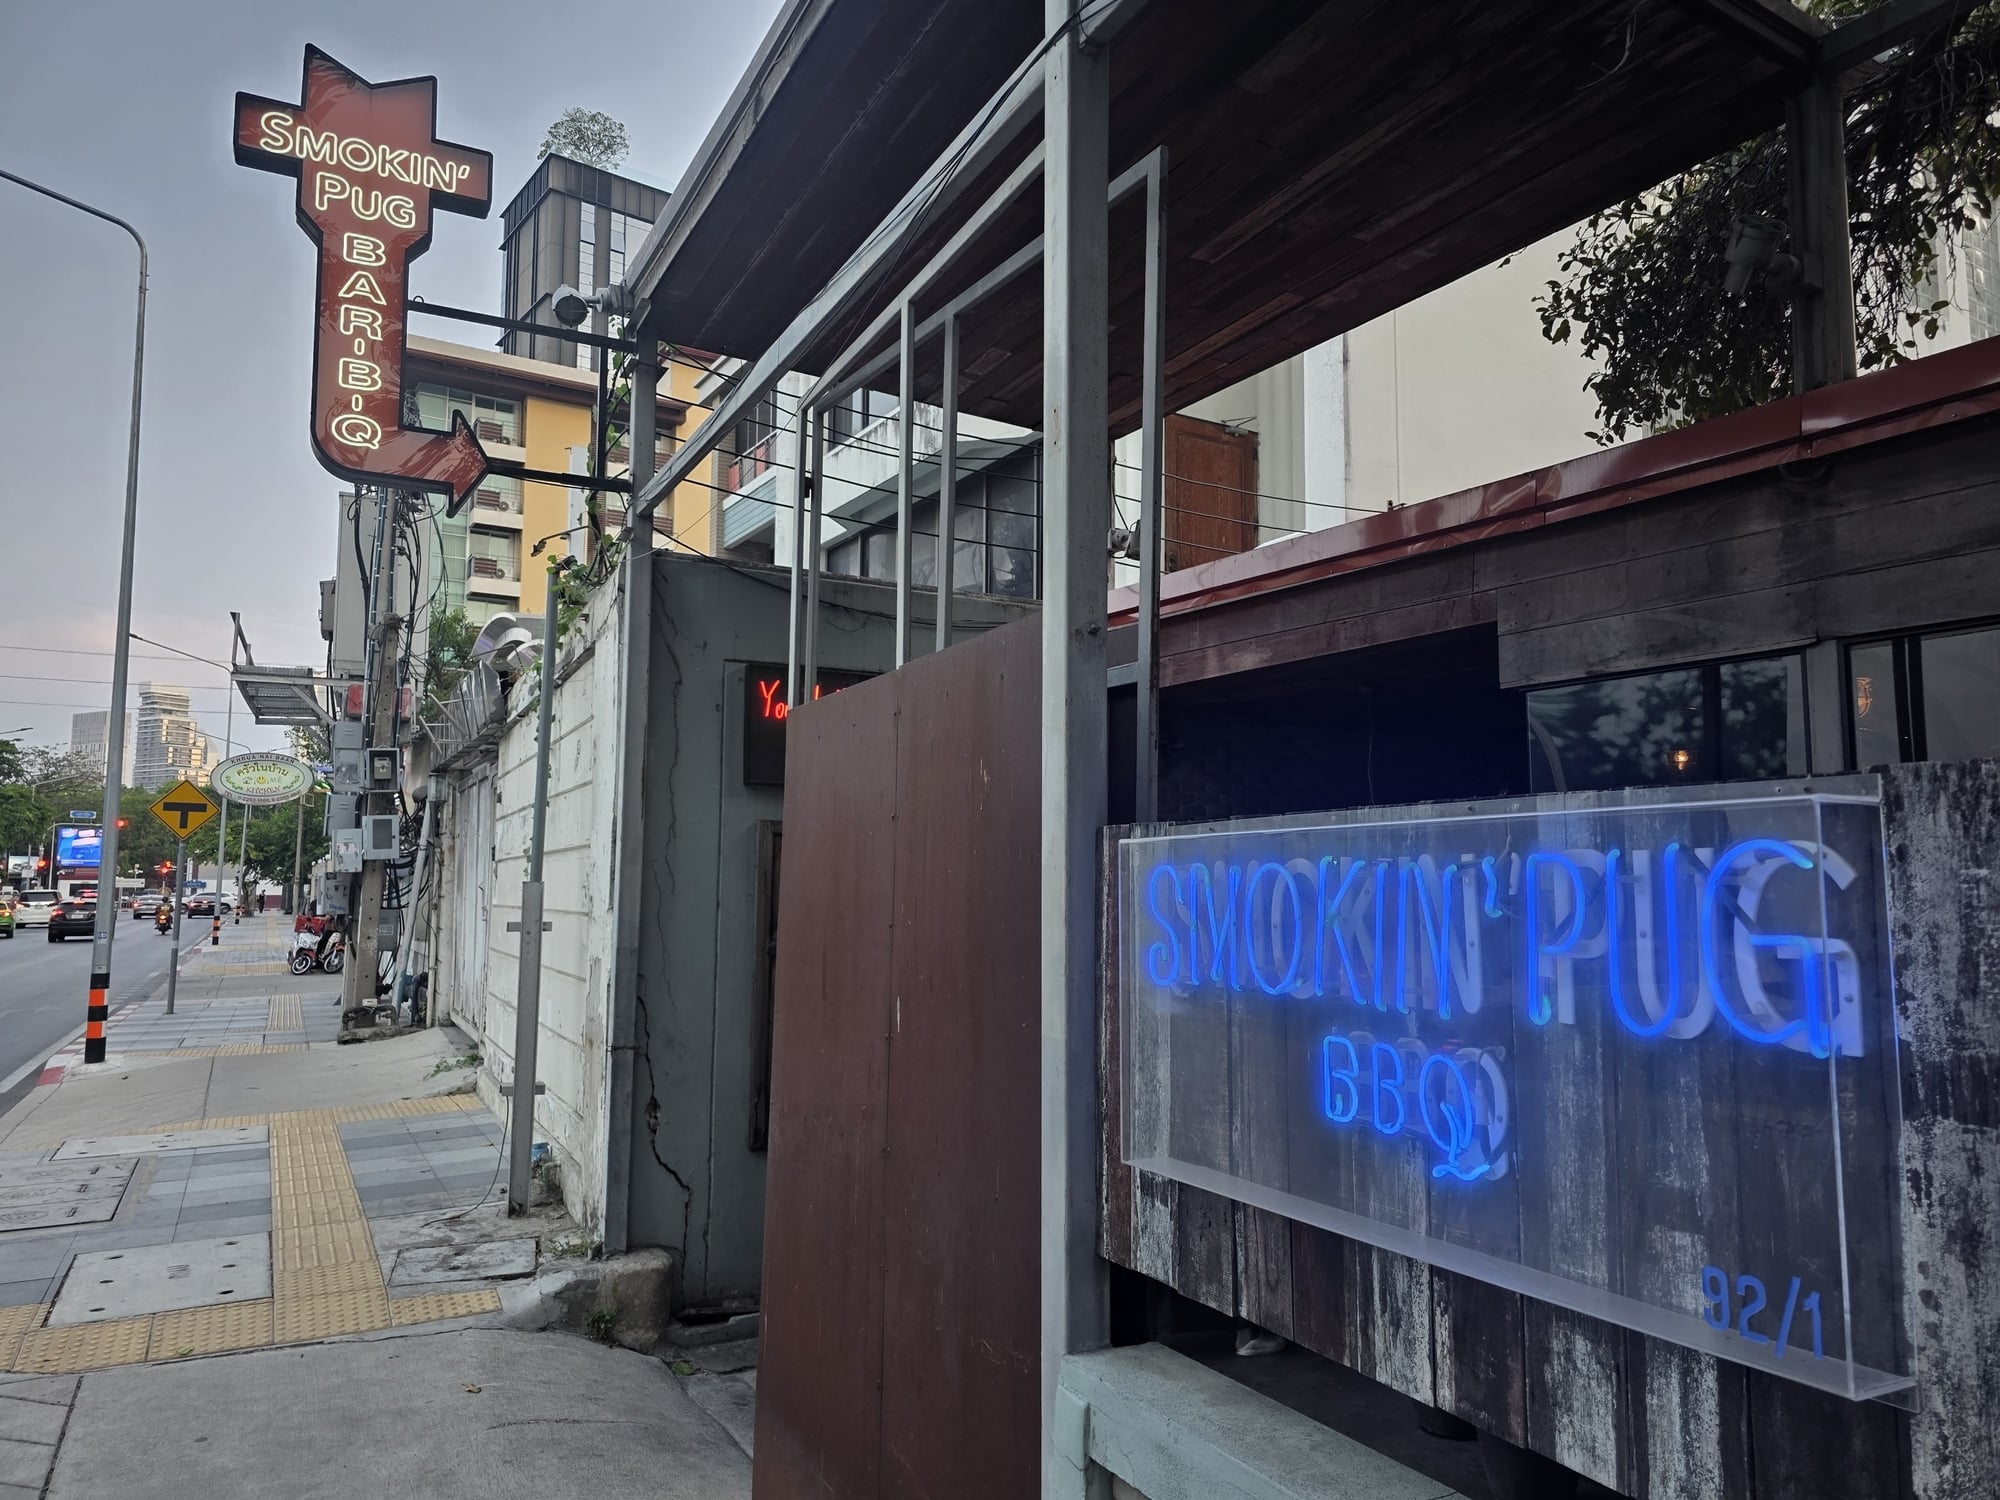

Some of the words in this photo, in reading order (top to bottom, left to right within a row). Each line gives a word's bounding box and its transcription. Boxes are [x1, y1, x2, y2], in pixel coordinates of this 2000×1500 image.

[259, 111, 471, 193] SMOKIN'
[315, 171, 416, 229] PUG
[236, 762, 290, 777] ครัวในบ้าน
[1524, 837, 1833, 1060] PUG
[1321, 1033, 1492, 1184] BBQ
[1702, 1264, 1824, 1360] 92/1
